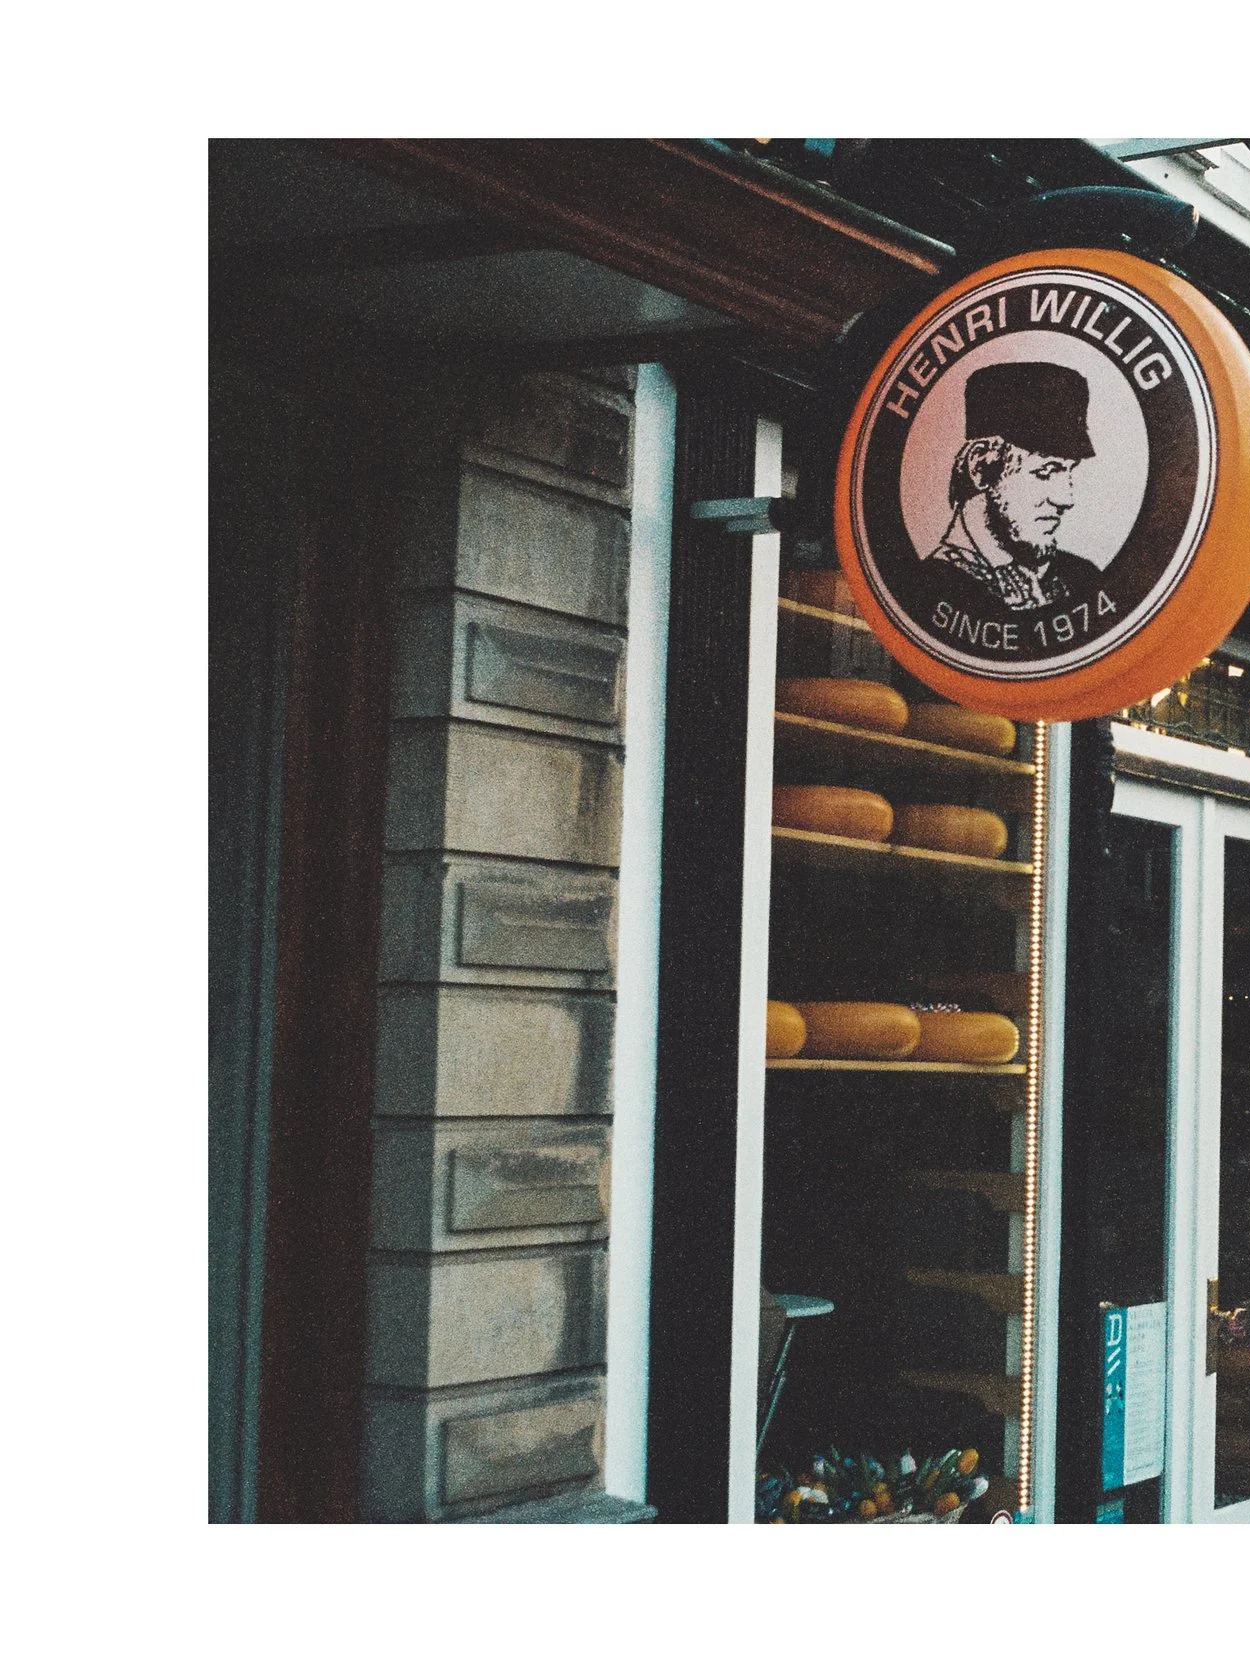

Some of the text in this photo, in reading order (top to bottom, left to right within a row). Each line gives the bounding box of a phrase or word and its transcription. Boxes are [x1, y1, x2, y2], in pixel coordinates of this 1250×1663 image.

[887, 288, 1172, 419] HENRI WILLIG
[932, 591, 1117, 651] SINCE 1974
